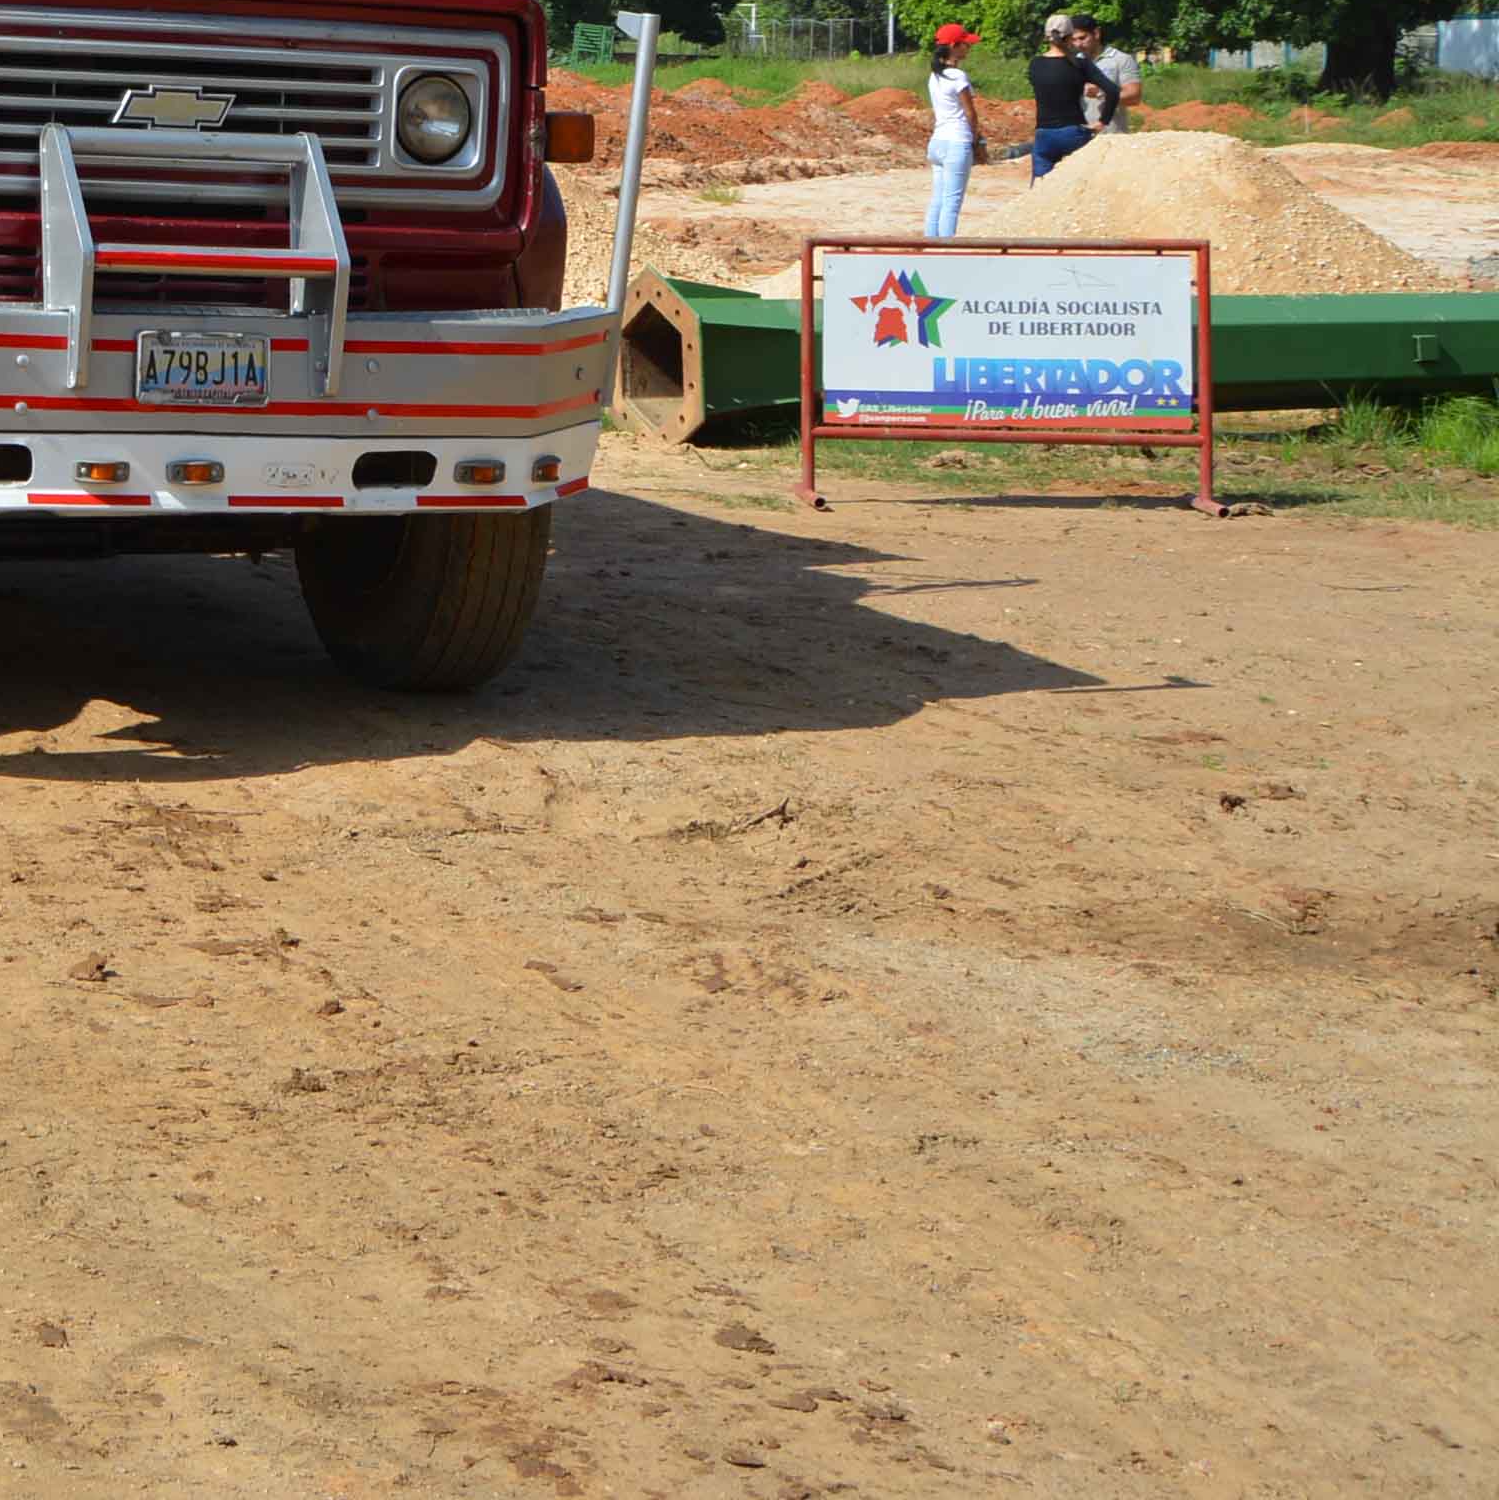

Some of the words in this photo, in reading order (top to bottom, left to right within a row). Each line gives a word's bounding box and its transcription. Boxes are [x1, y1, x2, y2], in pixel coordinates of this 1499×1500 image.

[962, 297, 1050, 315] ALCALDÍA
[1056, 300, 1163, 316] SOCIALISTA
[988, 321, 1013, 336] DE
[1019, 321, 1136, 337] LIBERTADOR
[145, 349, 259, 386] A79BJ1A
[933, 357, 1184, 395] LIBERTADOR
[963, 399, 1005, 420] ¡Para
[1011, 398, 1028, 420] el
[1031, 395, 1078, 419] buen
[1086, 394, 1138, 417] vivir!
